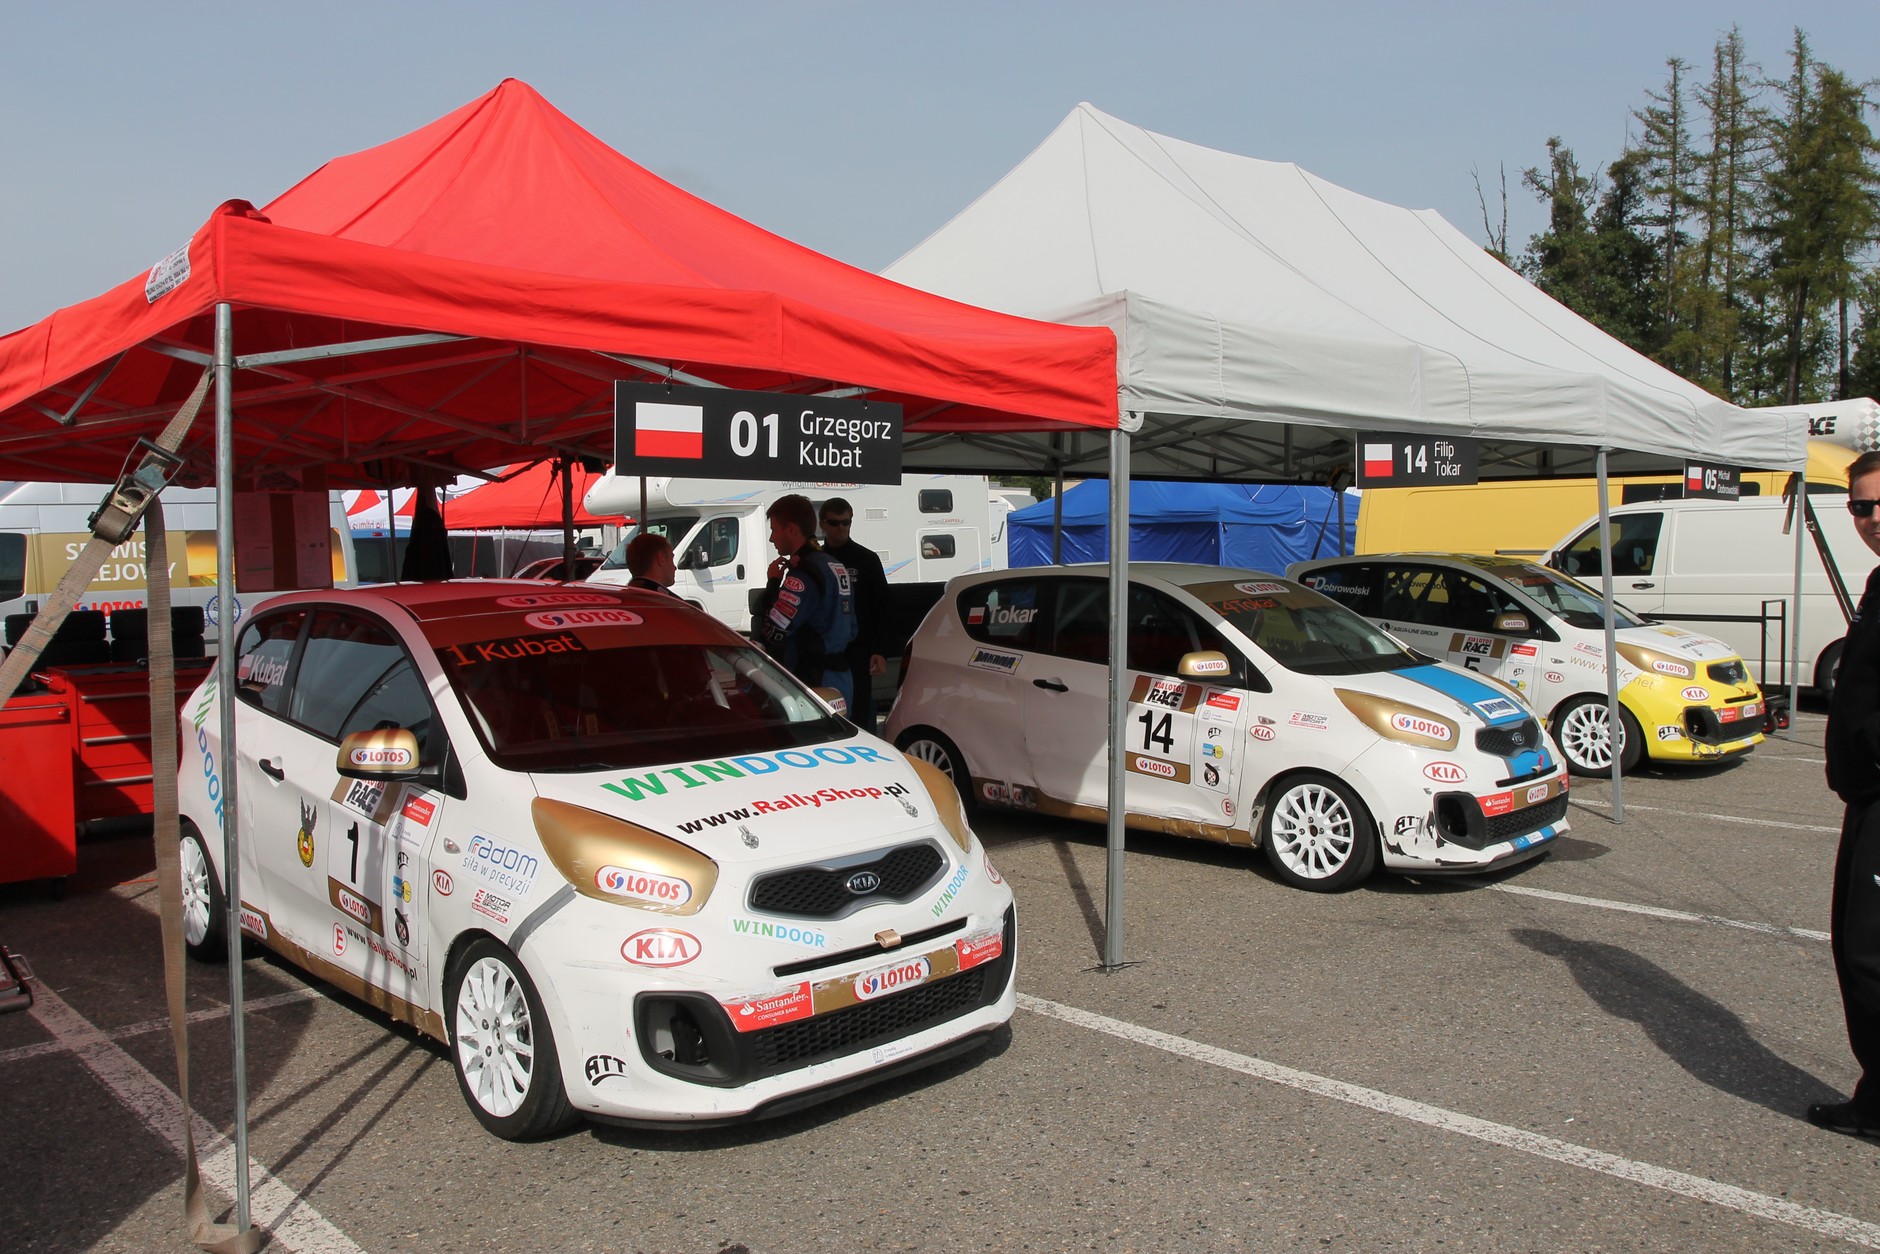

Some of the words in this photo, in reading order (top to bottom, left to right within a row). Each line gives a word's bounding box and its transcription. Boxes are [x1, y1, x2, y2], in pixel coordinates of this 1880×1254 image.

[730, 410, 779, 458] 01
[800, 410, 892, 443] Grzegorz
[799, 441, 862, 468] Kubat
[1404, 445, 1428, 474] 14
[1434, 441, 1455, 460] Filip
[1434, 461, 1462, 476] Tokar
[1705, 468, 1717, 490] 05
[65, 541, 146, 561] SWIS
[787, 577, 800, 590] KIA
[1313, 576, 1370, 596] Dobrowolski
[539, 595, 609, 604] LOTOS
[1207, 599, 1241, 617] 14
[1230, 598, 1279, 611] Tokar
[563, 611, 632, 624] LOTOS
[989, 605, 1038, 624] Tokar
[447, 645, 476, 667] 1
[476, 635, 582, 662] Kubat
[1462, 642, 1490, 655] RACE
[249, 654, 288, 687] Kubat
[1204, 661, 1224, 670] LOTOS
[1464, 656, 1480, 673] 5
[1665, 664, 1686, 674] LOTOS
[1154, 681, 1165, 689] KIA
[1165, 683, 1185, 693] LOTOS
[1548, 673, 1561, 682] KIA
[1146, 688, 1183, 707] RACE
[1215, 696, 1237, 705] Santander
[1686, 690, 1705, 698] KIA
[1138, 709, 1174, 754] 14
[1208, 727, 1222, 737] ATT
[1254, 728, 1272, 739] KIA
[1412, 721, 1446, 737] LOTOS
[369, 751, 404, 762] LOTOS
[599, 746, 896, 801] WINDOOR
[1148, 762, 1172, 774] LOTOS
[1432, 766, 1461, 779] KIA
[346, 781, 382, 813] RACE
[1491, 796, 1511, 806] Santander
[676, 783, 910, 834] www.RallyShop.pl
[347, 821, 359, 885] 1
[467, 835, 538, 878] radom
[436, 873, 450, 893] KIA
[462, 856, 478, 872] siła
[480, 865, 489, 876] w
[488, 869, 532, 895] precyzji
[852, 875, 877, 890] KIA
[627, 875, 681, 900] LOTOS
[931, 865, 969, 918] WINDOOR
[349, 898, 368, 920] LOTOS
[482, 899, 507, 914] SPORT
[485, 893, 511, 909] MOTOR
[335, 928, 344, 951] E
[732, 918, 826, 948] WINDOOR
[635, 937, 689, 959] KIA
[881, 962, 922, 991] LOTOS
[756, 992, 806, 1012] Santander
[757, 1010, 785, 1021] CONSUMER
[785, 1006, 799, 1015] BANK
[585, 1055, 627, 1081] ATT
